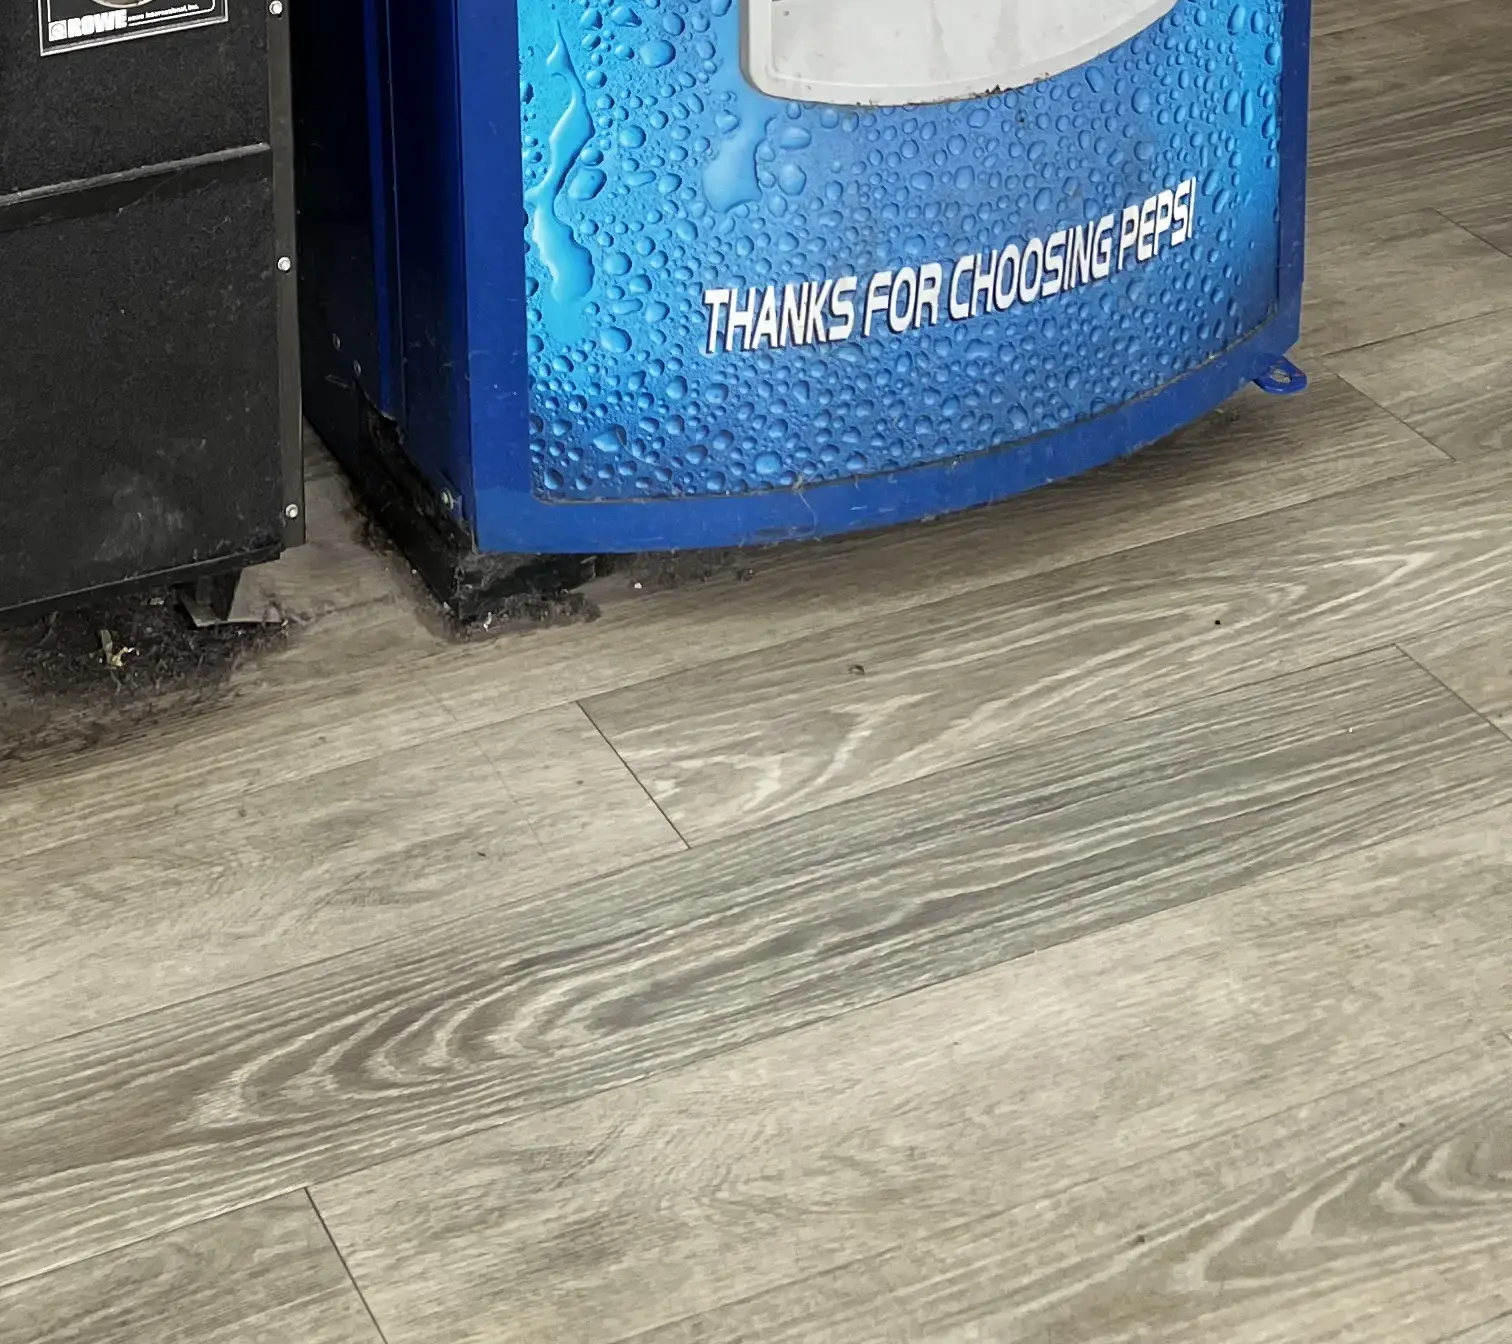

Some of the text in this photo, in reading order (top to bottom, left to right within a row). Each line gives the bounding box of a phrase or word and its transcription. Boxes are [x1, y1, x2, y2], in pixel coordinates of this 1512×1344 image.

[67, 9, 128, 39] ROWE
[702, 175, 1198, 355] THANKS FOR CHOOSING PEPSI
